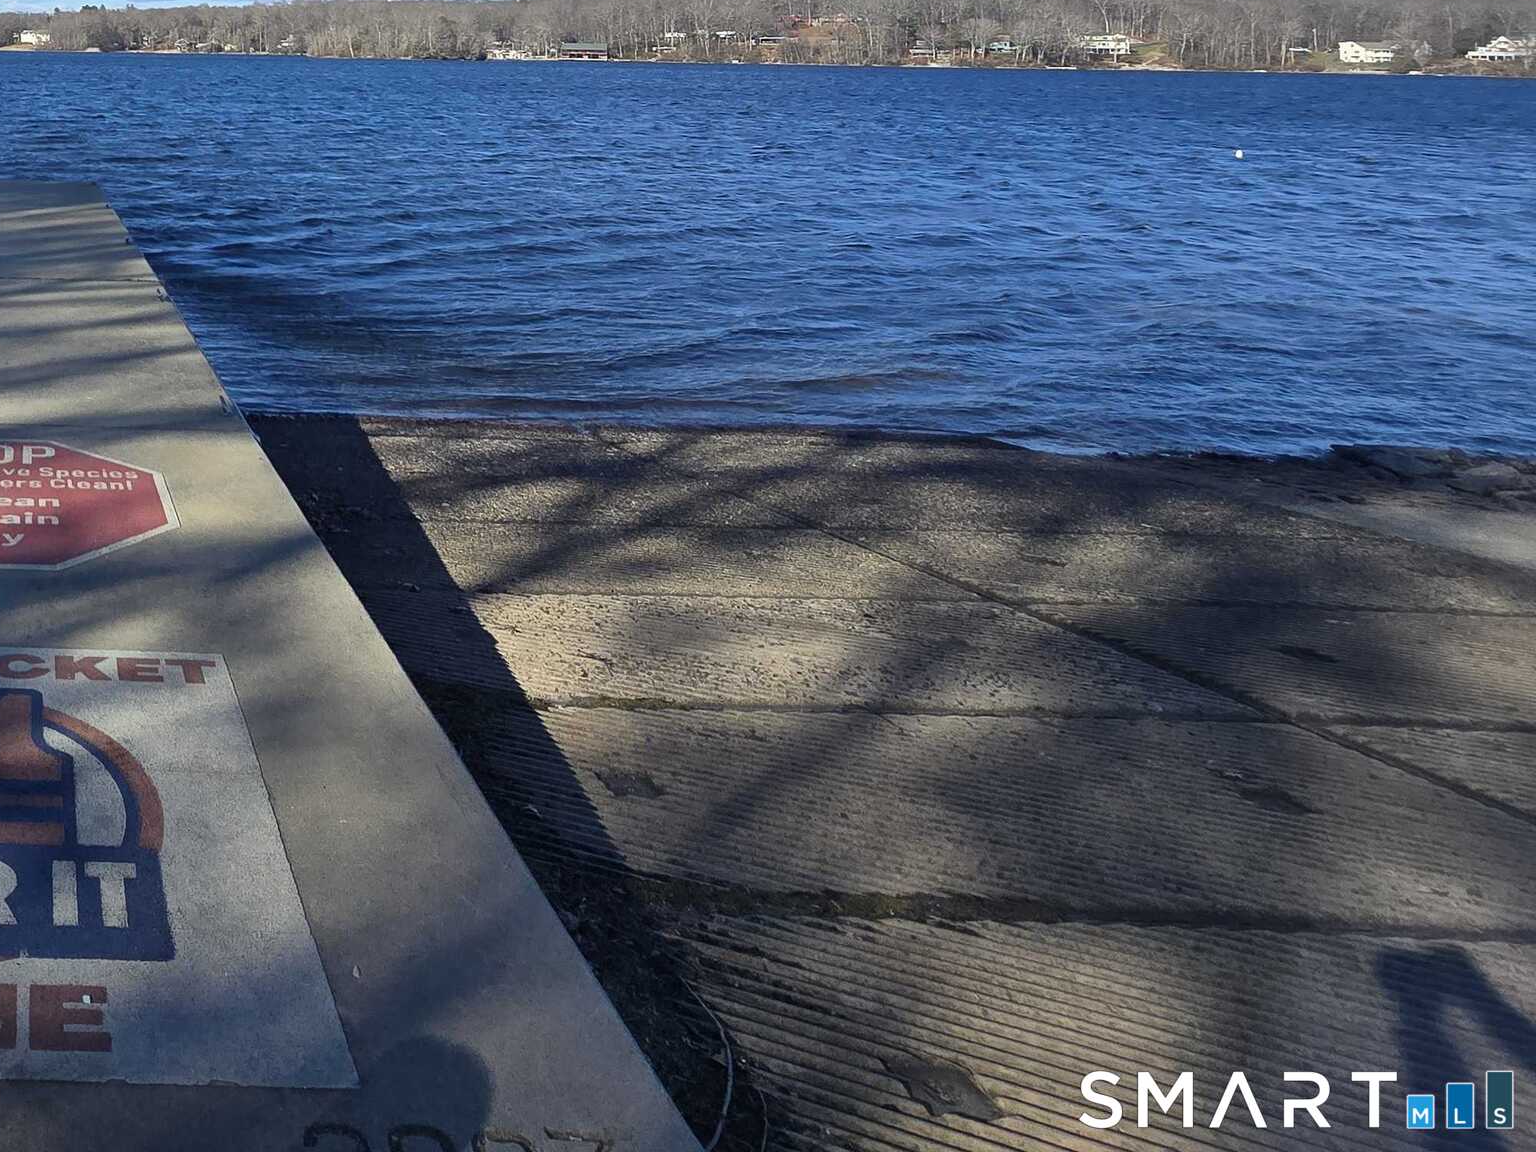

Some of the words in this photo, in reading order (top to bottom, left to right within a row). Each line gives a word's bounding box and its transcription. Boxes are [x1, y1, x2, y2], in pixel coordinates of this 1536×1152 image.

[39, 467, 139, 480] Species
[50, 479, 134, 491] Clean!
[52, 860, 137, 929] IT
